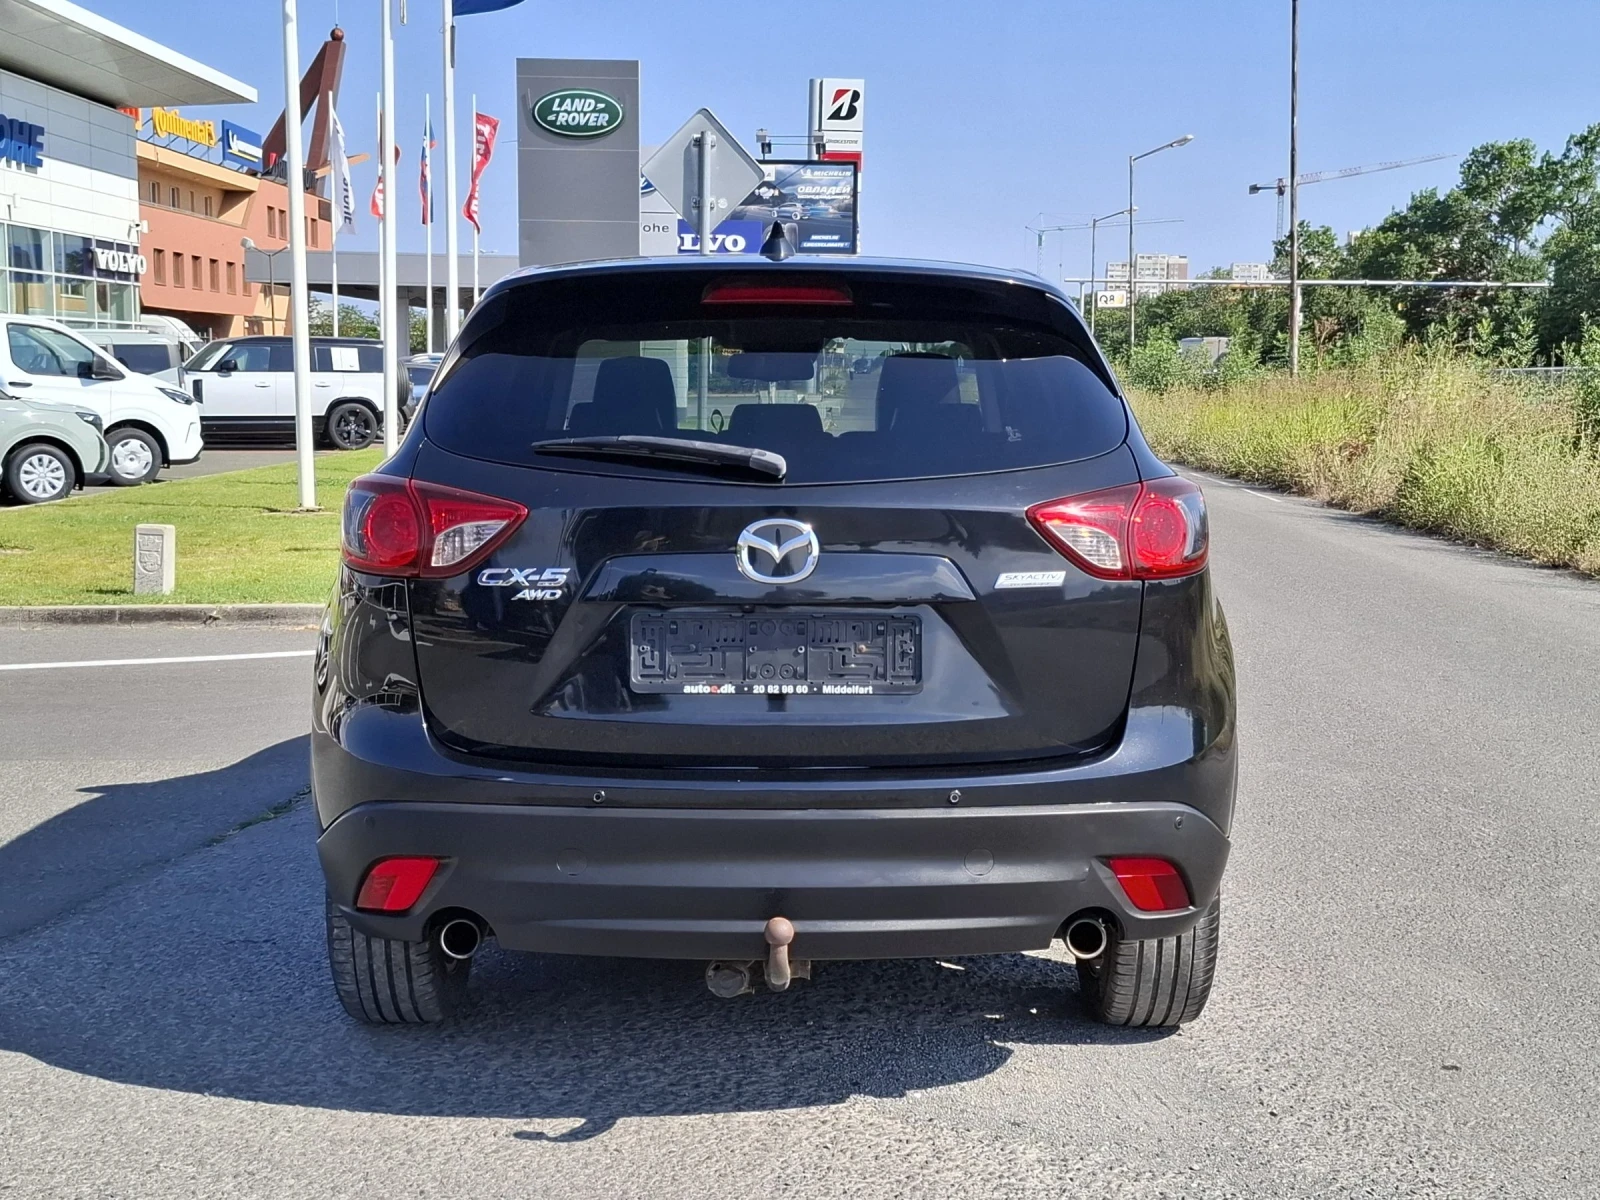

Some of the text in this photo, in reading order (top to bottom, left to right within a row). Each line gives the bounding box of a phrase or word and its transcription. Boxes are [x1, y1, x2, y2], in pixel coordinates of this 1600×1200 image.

[555, 112, 609, 126] ROVER
[93, 247, 147, 274] VOLVO
[1100, 294, 1115, 305] Q8
[477, 567, 571, 586] CX-5
[511, 588, 562, 601] AWD
[752, 684, 766, 694] 20
